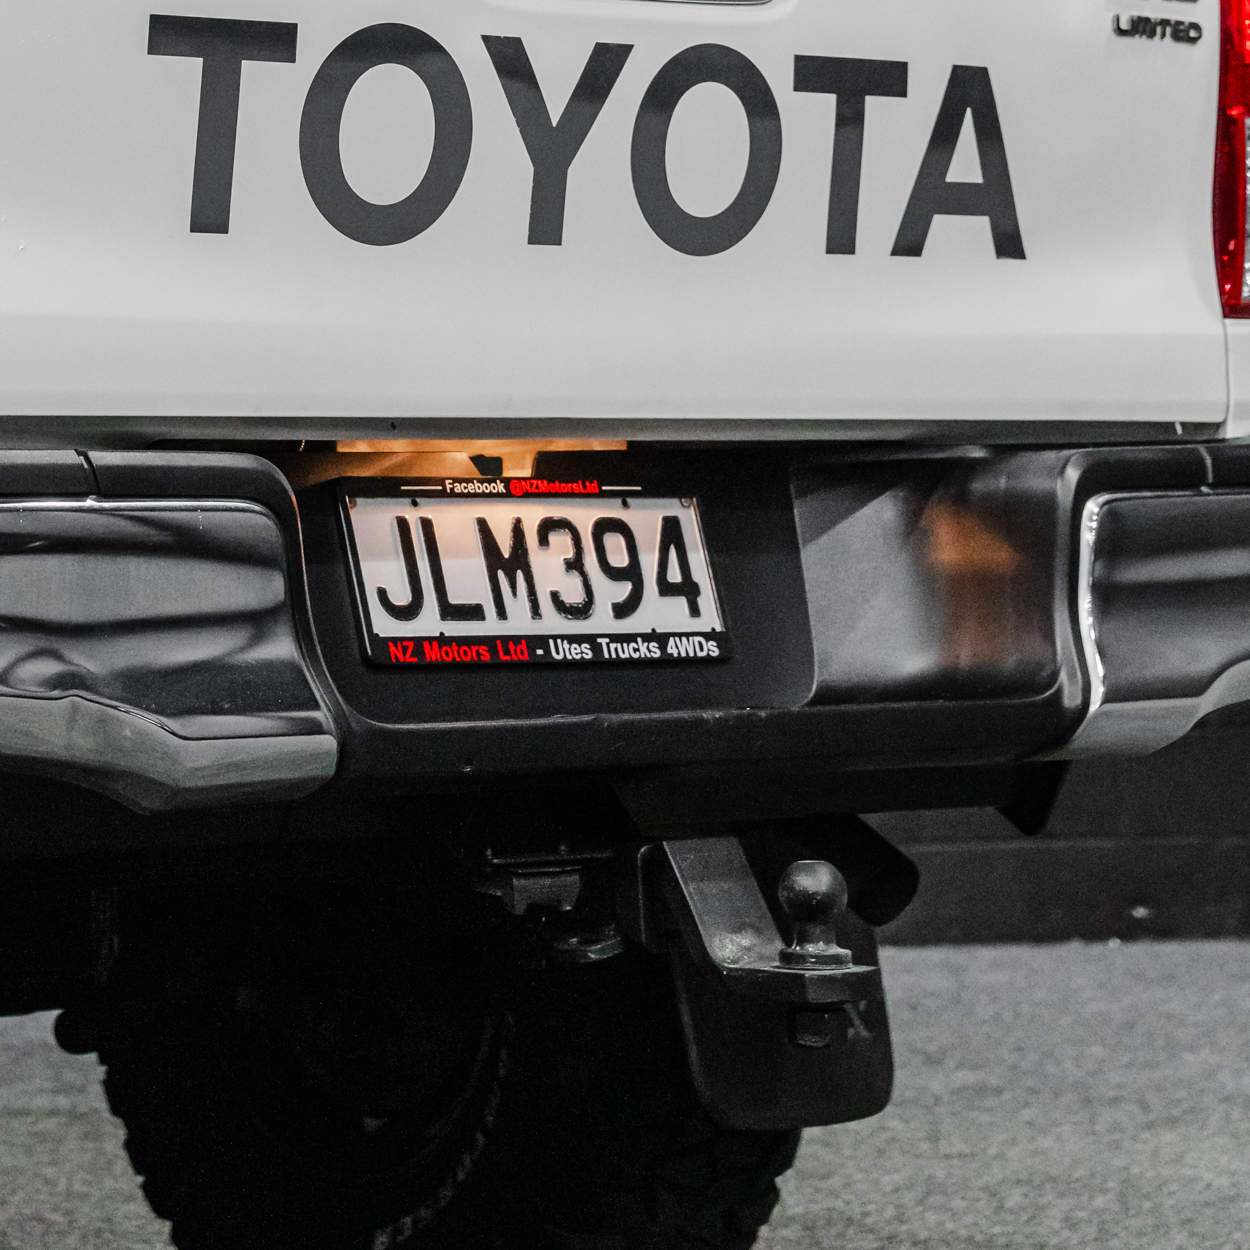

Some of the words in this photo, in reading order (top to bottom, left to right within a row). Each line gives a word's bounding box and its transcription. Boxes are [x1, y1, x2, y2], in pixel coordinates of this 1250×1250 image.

[147, 14, 1027, 261] TOYOTA
[445, 479, 506, 494] Facebook
[509, 478, 600, 496] @NZMotorsLtd
[376, 514, 702, 622] JLM394
[388, 641, 418, 663] NZ
[423, 640, 491, 662] Motors
[497, 639, 529, 661] Ltd
[549, 638, 593, 660] Utes
[596, 637, 661, 659] Trucks
[667, 636, 720, 658] 4WDs
